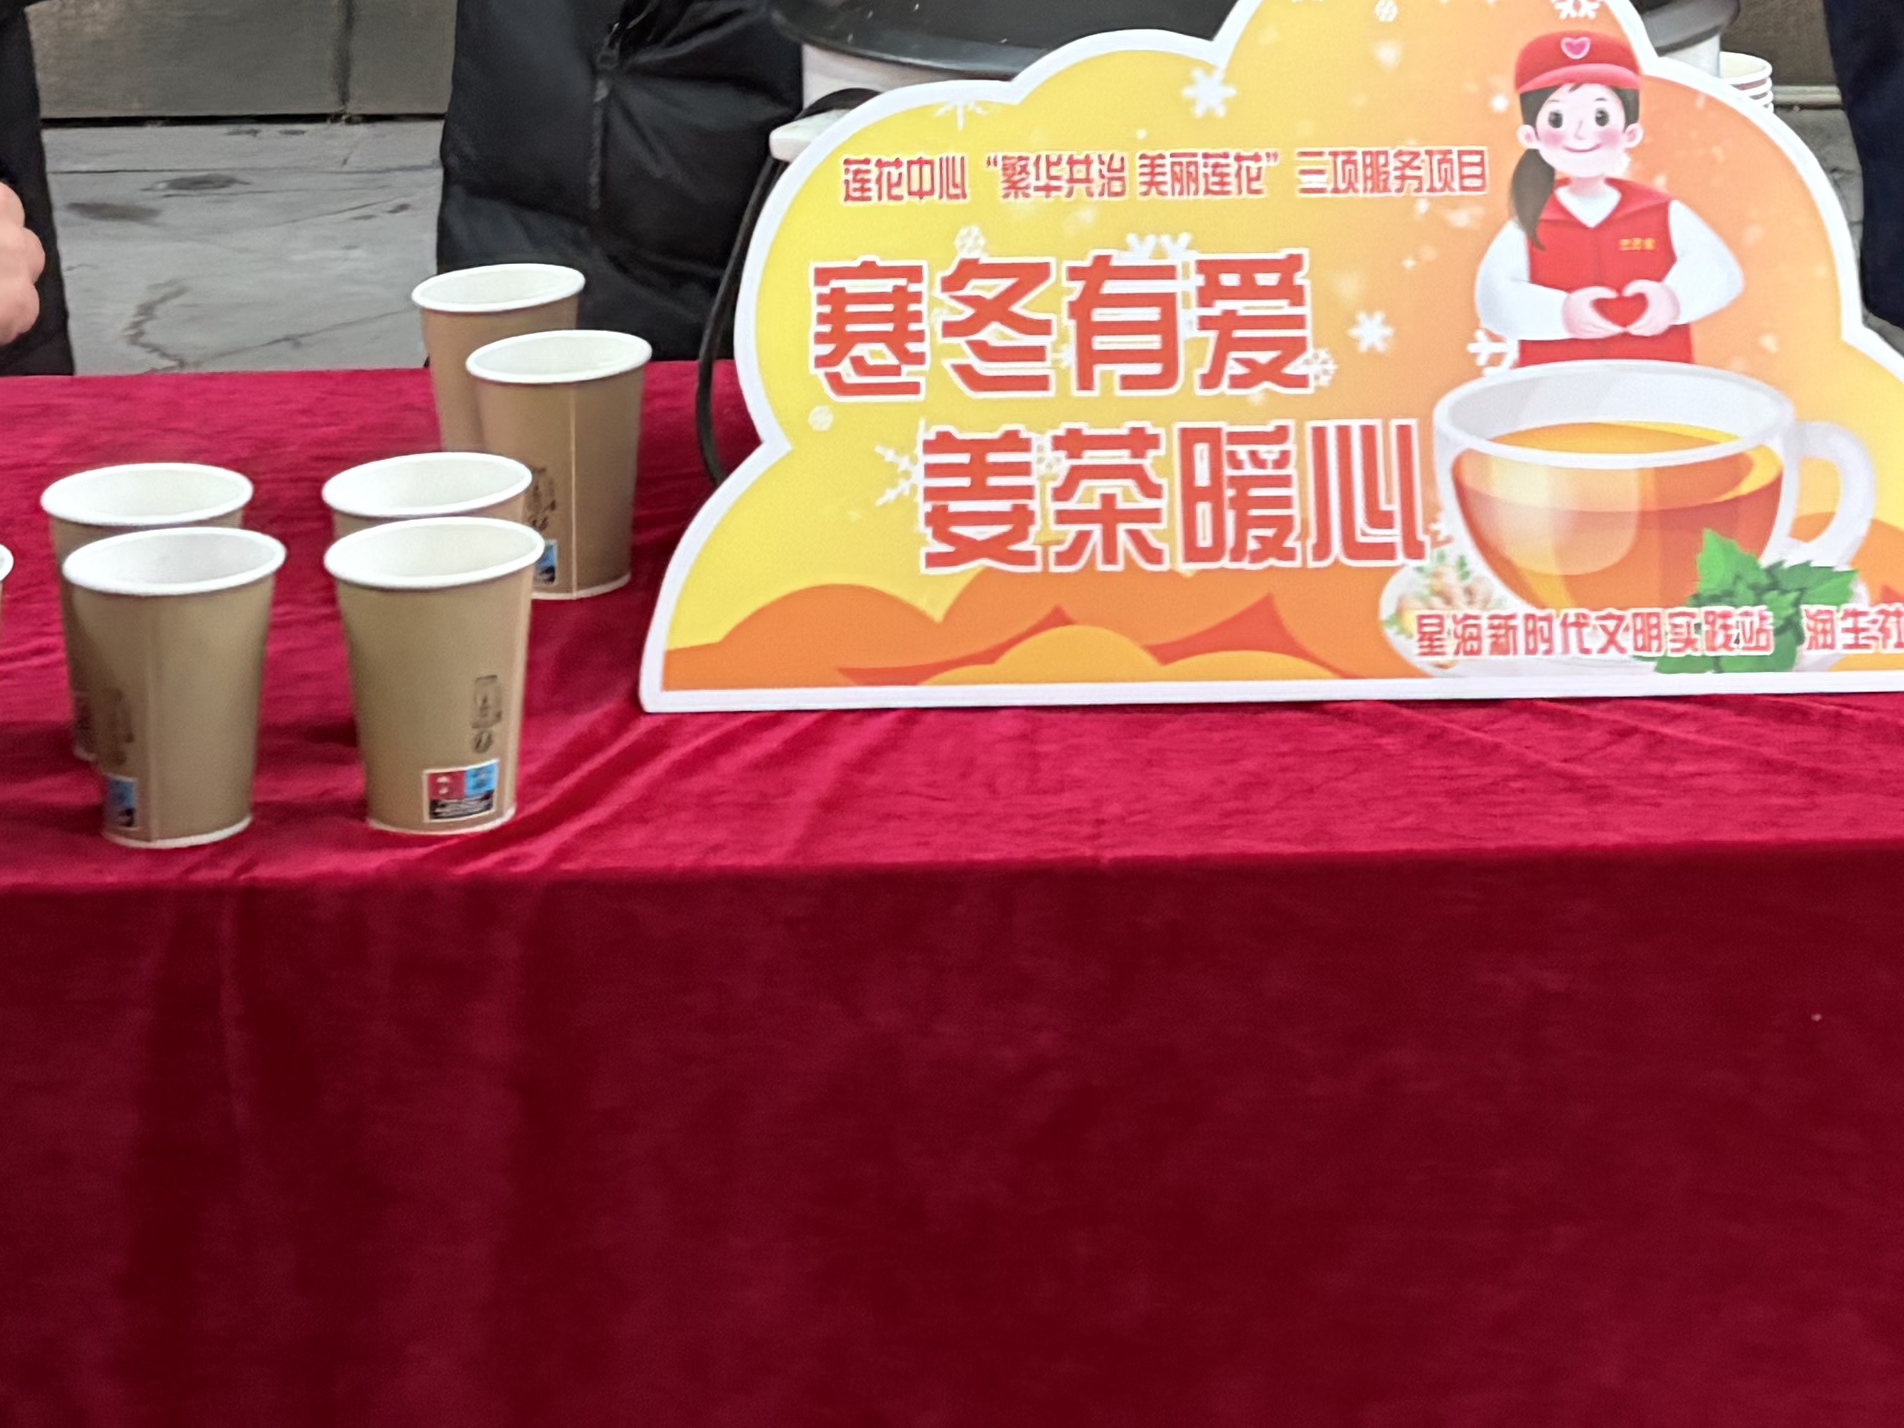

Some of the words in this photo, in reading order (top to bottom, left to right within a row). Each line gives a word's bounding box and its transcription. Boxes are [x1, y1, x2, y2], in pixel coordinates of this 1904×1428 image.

[811, 250, 1313, 398] 寒冬有爱
[920, 419, 1429, 572] 姜茶暖心
